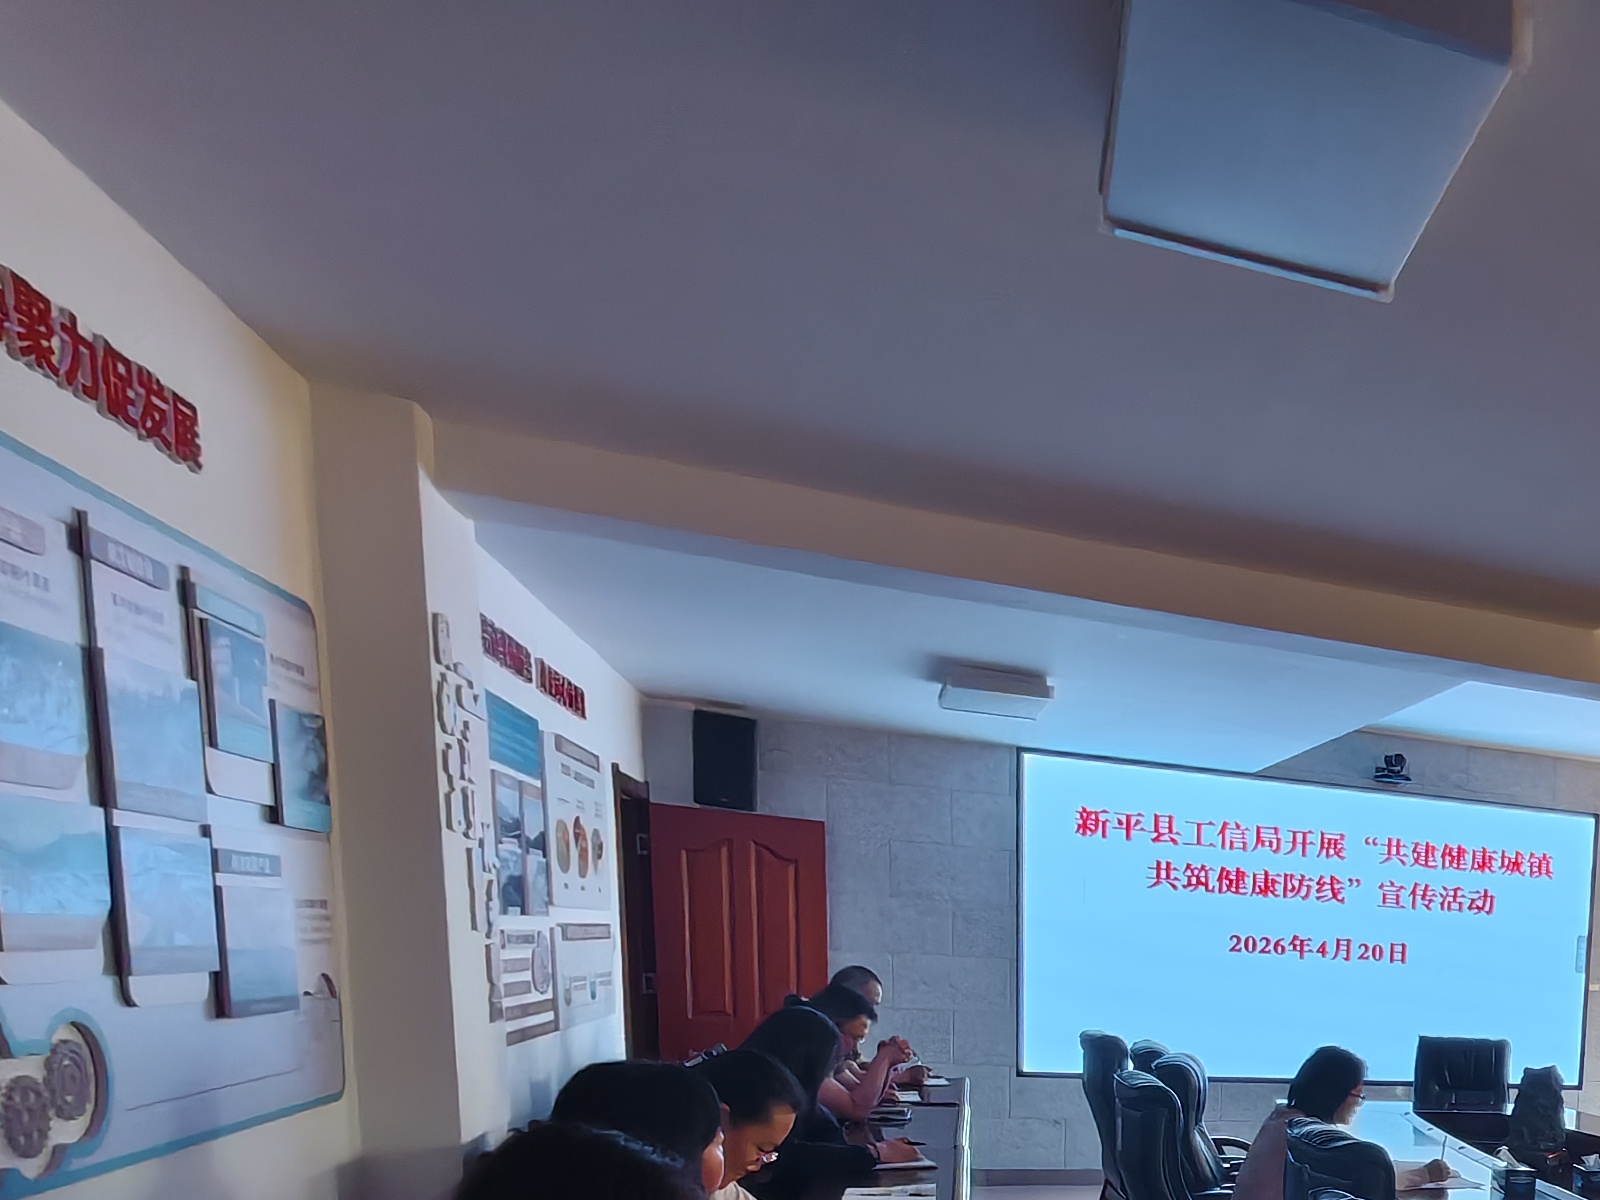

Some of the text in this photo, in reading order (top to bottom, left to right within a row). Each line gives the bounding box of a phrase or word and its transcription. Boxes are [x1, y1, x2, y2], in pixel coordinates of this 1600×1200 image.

[0, 264, 202, 473] 聚力促发展
[1228, 934, 1409, 964] 2026年4月20日
